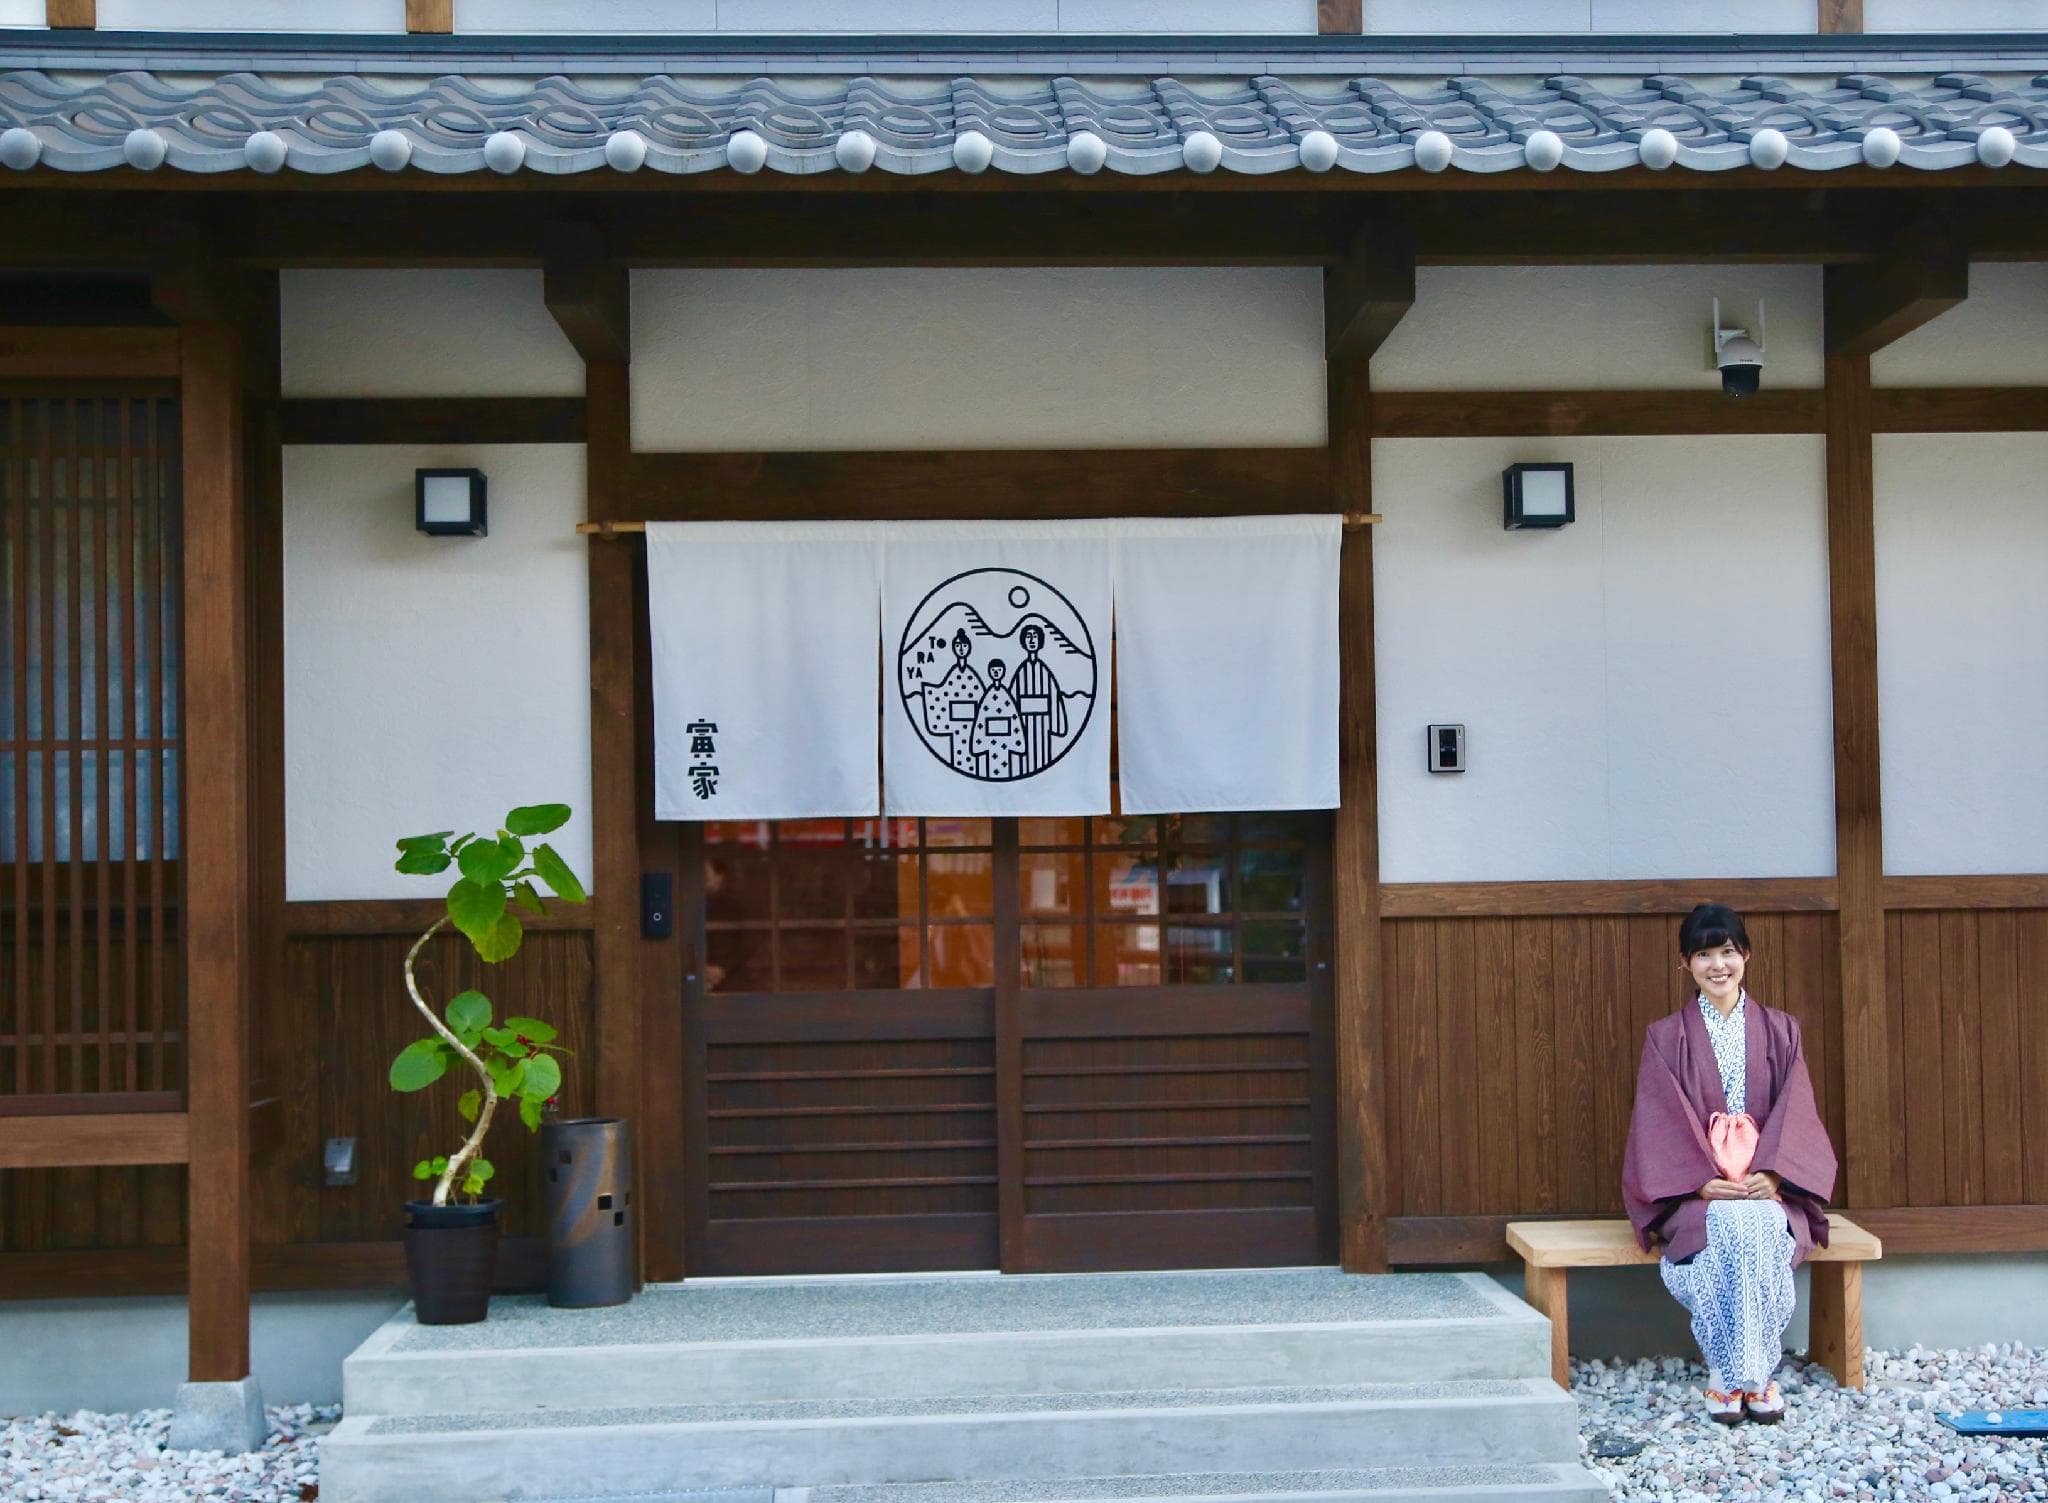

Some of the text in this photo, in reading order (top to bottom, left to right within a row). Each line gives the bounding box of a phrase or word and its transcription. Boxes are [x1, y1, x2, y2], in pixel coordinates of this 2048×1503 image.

[929, 637, 946, 649] TO
[917, 652, 935, 664] RA
[906, 667, 923, 679] YA
[686, 718, 720, 800] 寅家
